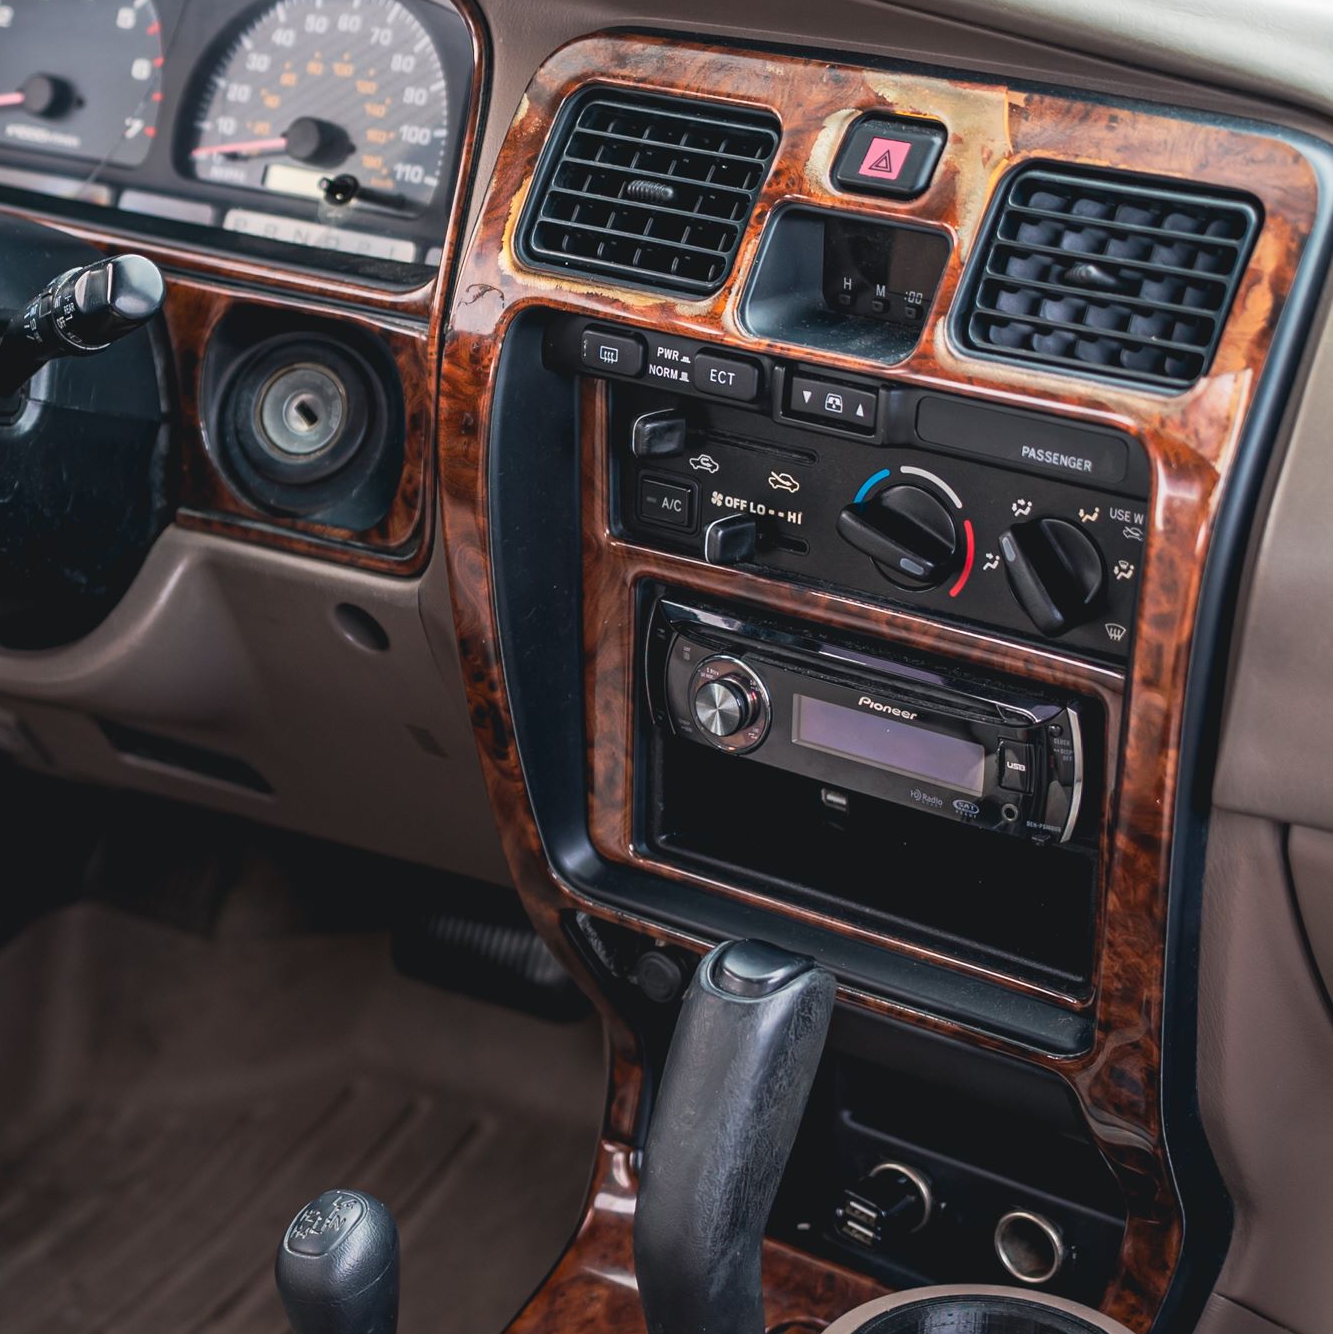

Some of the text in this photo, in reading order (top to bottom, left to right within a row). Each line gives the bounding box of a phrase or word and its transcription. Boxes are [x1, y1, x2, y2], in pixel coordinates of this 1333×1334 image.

[305, 15, 328, 33] 50
[272, 29, 296, 47] 40
[370, 28, 393, 46] 70
[246, 54, 270, 72] 30
[124, 117, 143, 139] 7
[217, 117, 236, 135] 10
[399, 125, 431, 145] 100
[394, 163, 424, 184] 110
[843, 277, 852, 290] H
[876, 284, 886, 297] M
[657, 346, 679, 361] PWR
[649, 364, 678, 380] NORM
[710, 369, 735, 385] ECT
[1021, 446, 1092, 472] PASSENGER
[661, 497, 682, 512] A/C
[725, 496, 803, 525] OFF LO HI
[1109, 507, 1131, 523] USE
[858, 696, 918, 720] Pioneer
[1006, 761, 1026, 772] USB
[922, 793, 943, 806] Radio
